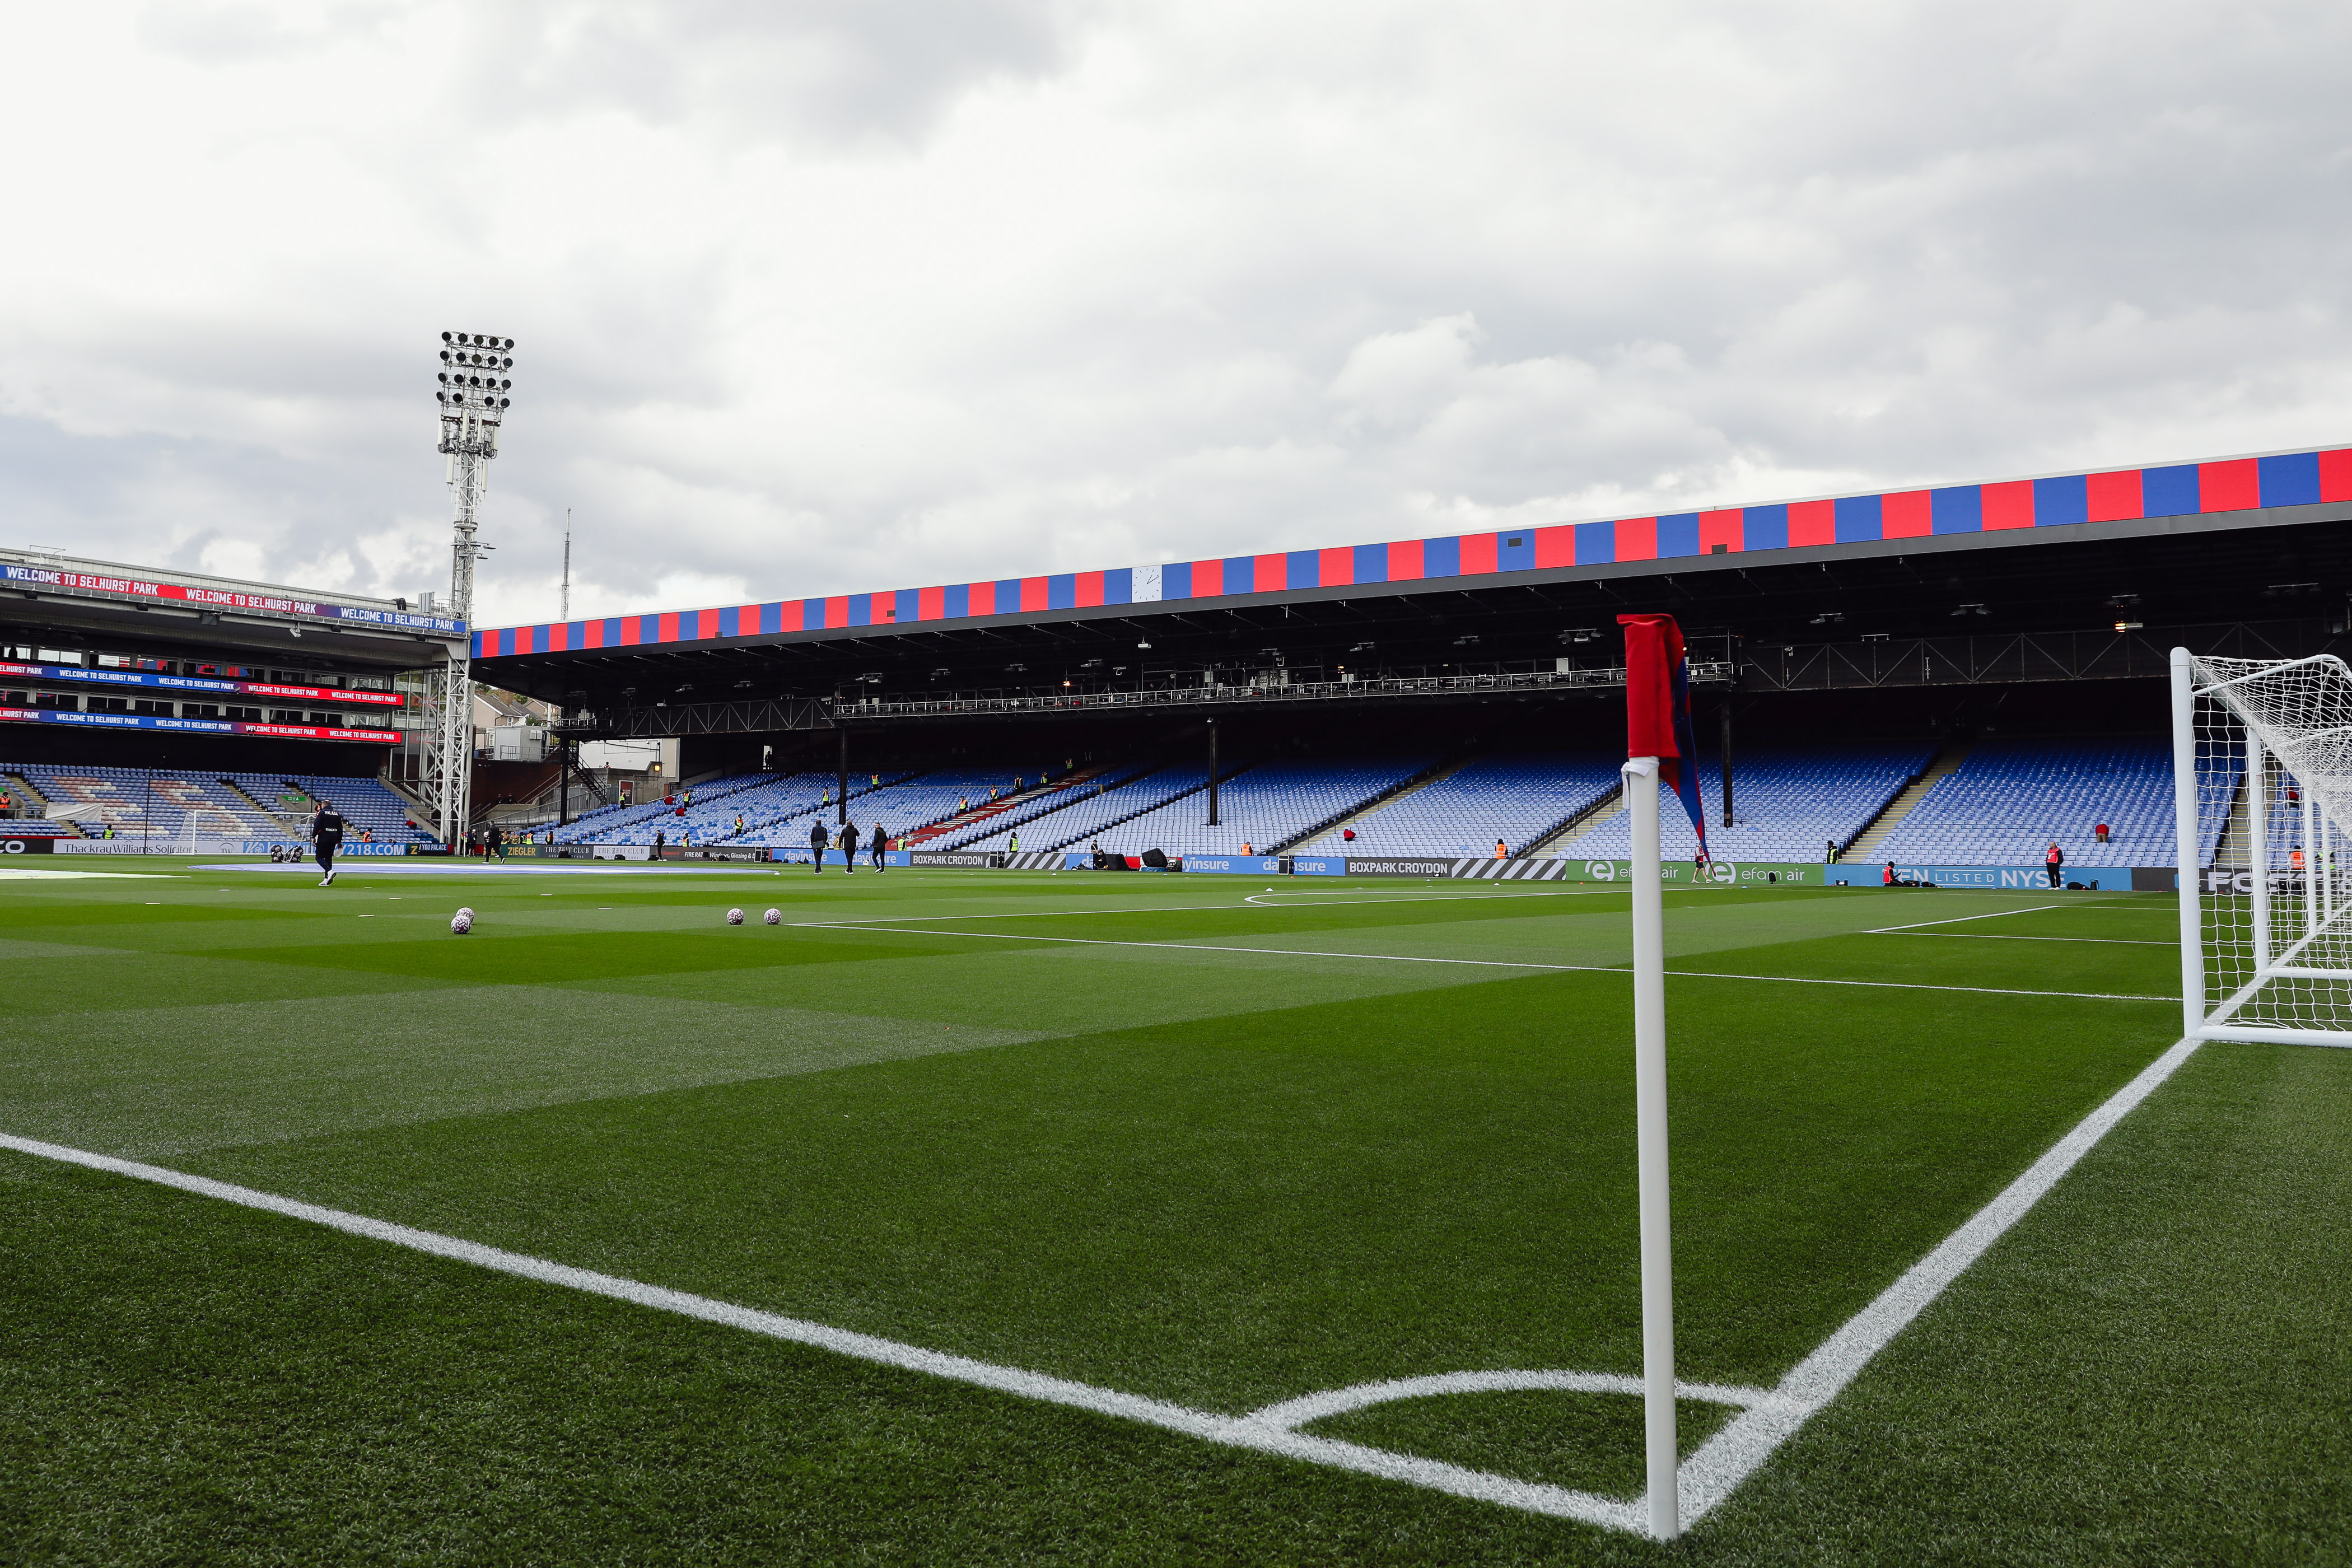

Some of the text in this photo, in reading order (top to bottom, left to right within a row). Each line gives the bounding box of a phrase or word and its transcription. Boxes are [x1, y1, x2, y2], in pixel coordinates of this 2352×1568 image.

[6, 566, 158, 595] WELCOME TO SELHURST PARK
[186, 588, 316, 614] WELCOME TO SELHURST PARK
[341, 607, 455, 631] WELCOME TO SELHURST PARK
[0, 665, 26, 674] ELHURST
[59, 669, 88, 678] WELCOME
[99, 673, 126, 682] SELHURST
[158, 678, 185, 687] WELCOME
[194, 681, 220, 689] SELHURST
[248, 685, 273, 693] WELCOME
[57, 713, 86, 722] WELCOME
[95, 716, 123, 725] SELHURST
[156, 720, 182, 728] WELCOME
[192, 722, 217, 730] SELHURST
[246, 725, 270, 733] WELCOME
[933, 787, 1058, 829] SOUTH LONDON
[64, 844, 197, 854] Thackray Williams Solicitors
[507, 847, 536, 856] ZIEGLER
[913, 855, 983, 865] BOXPARK CROYDON
[1350, 862, 1448, 874] BOXPARK CROYDON
[1662, 866, 1678, 878] air
[1786, 868, 1805, 881] air
[1935, 873, 1995, 883] LISTED
